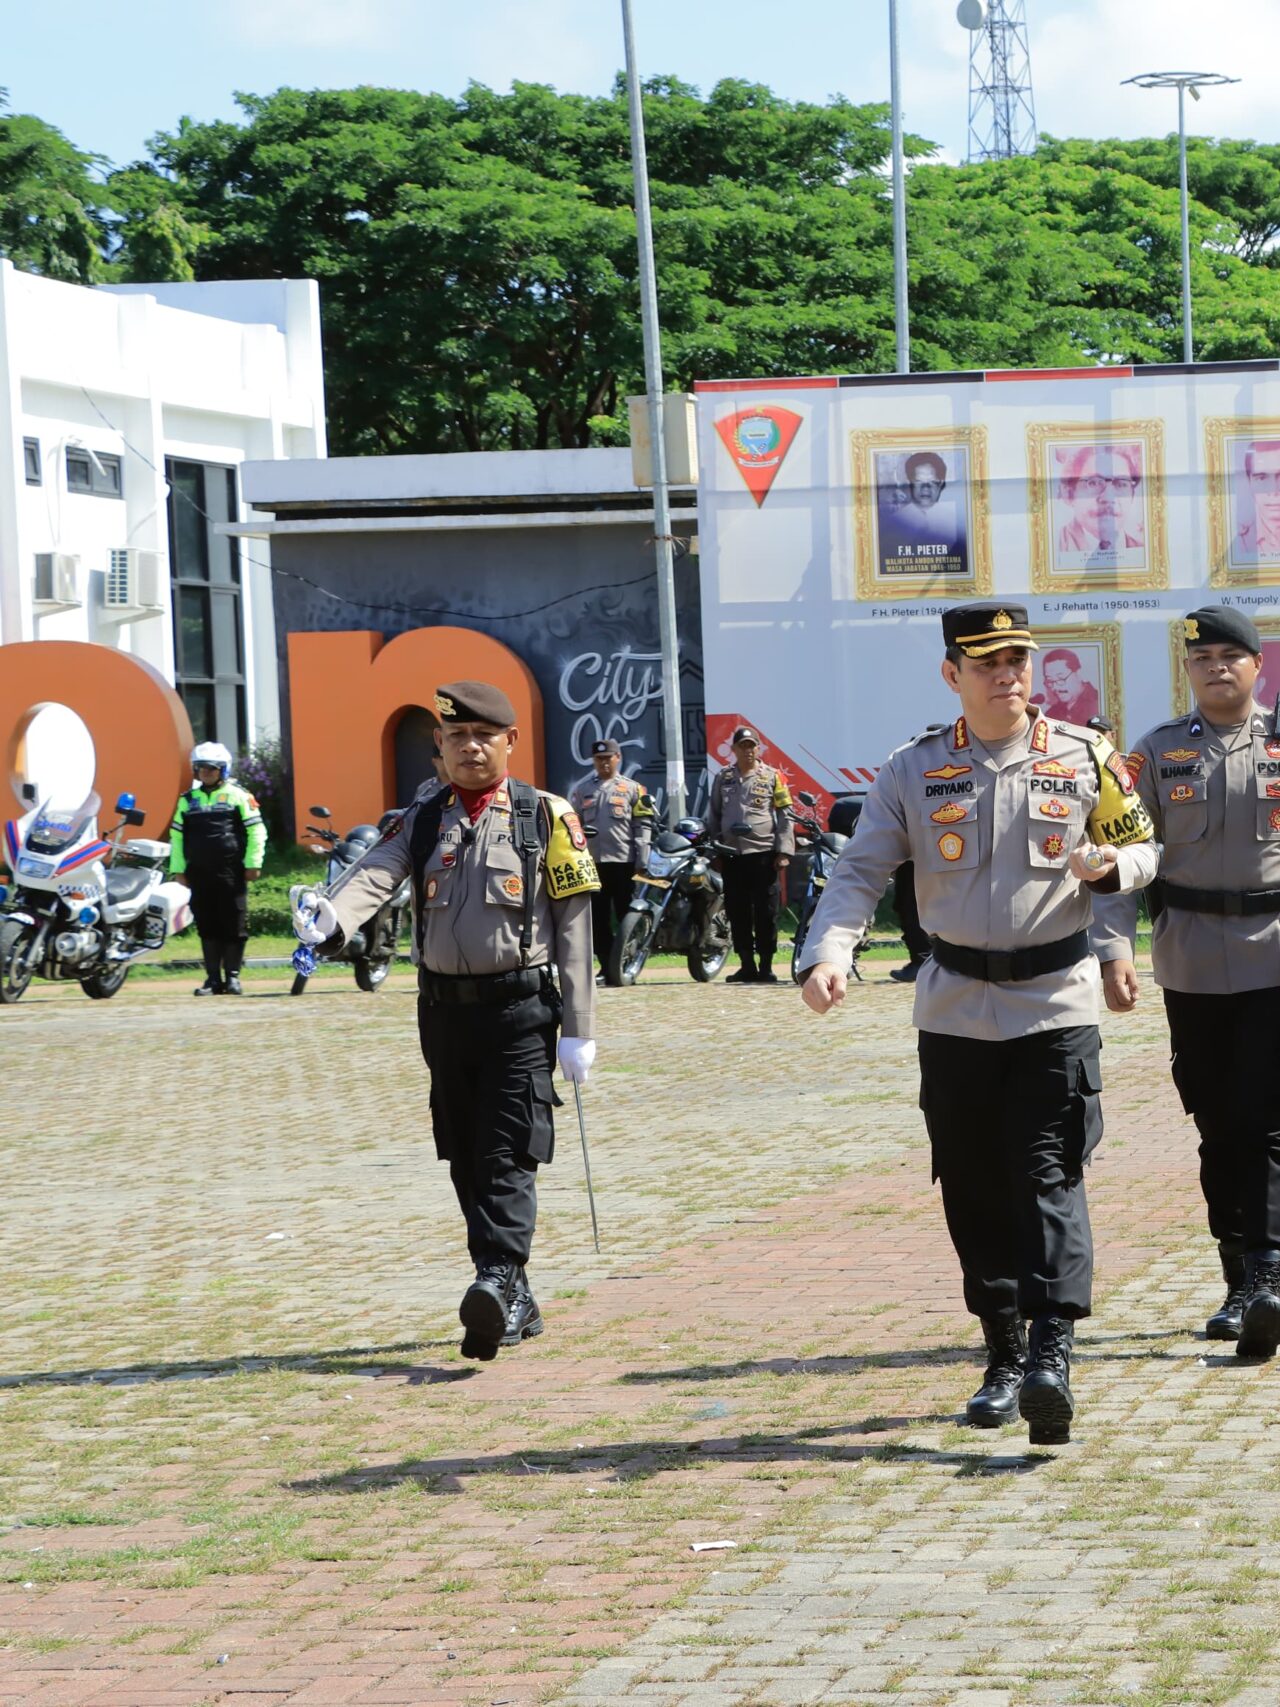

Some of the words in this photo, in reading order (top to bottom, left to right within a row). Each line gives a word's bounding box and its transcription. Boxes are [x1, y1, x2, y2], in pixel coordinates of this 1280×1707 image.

[898, 545, 914, 556] F.H.
[917, 544, 948, 555] PIETER
[1062, 601, 1098, 611] Rehatta
[1101, 598, 1160, 610] (1950-1953)
[1221, 596, 1233, 605] W.
[1236, 594, 1279, 605] Tutupoly
[891, 607, 919, 617] Pieter
[559, 645, 666, 720] City
[926, 780, 973, 797] DRIYANO
[1030, 780, 1077, 794] POLRI
[552, 863, 574, 876] KA
